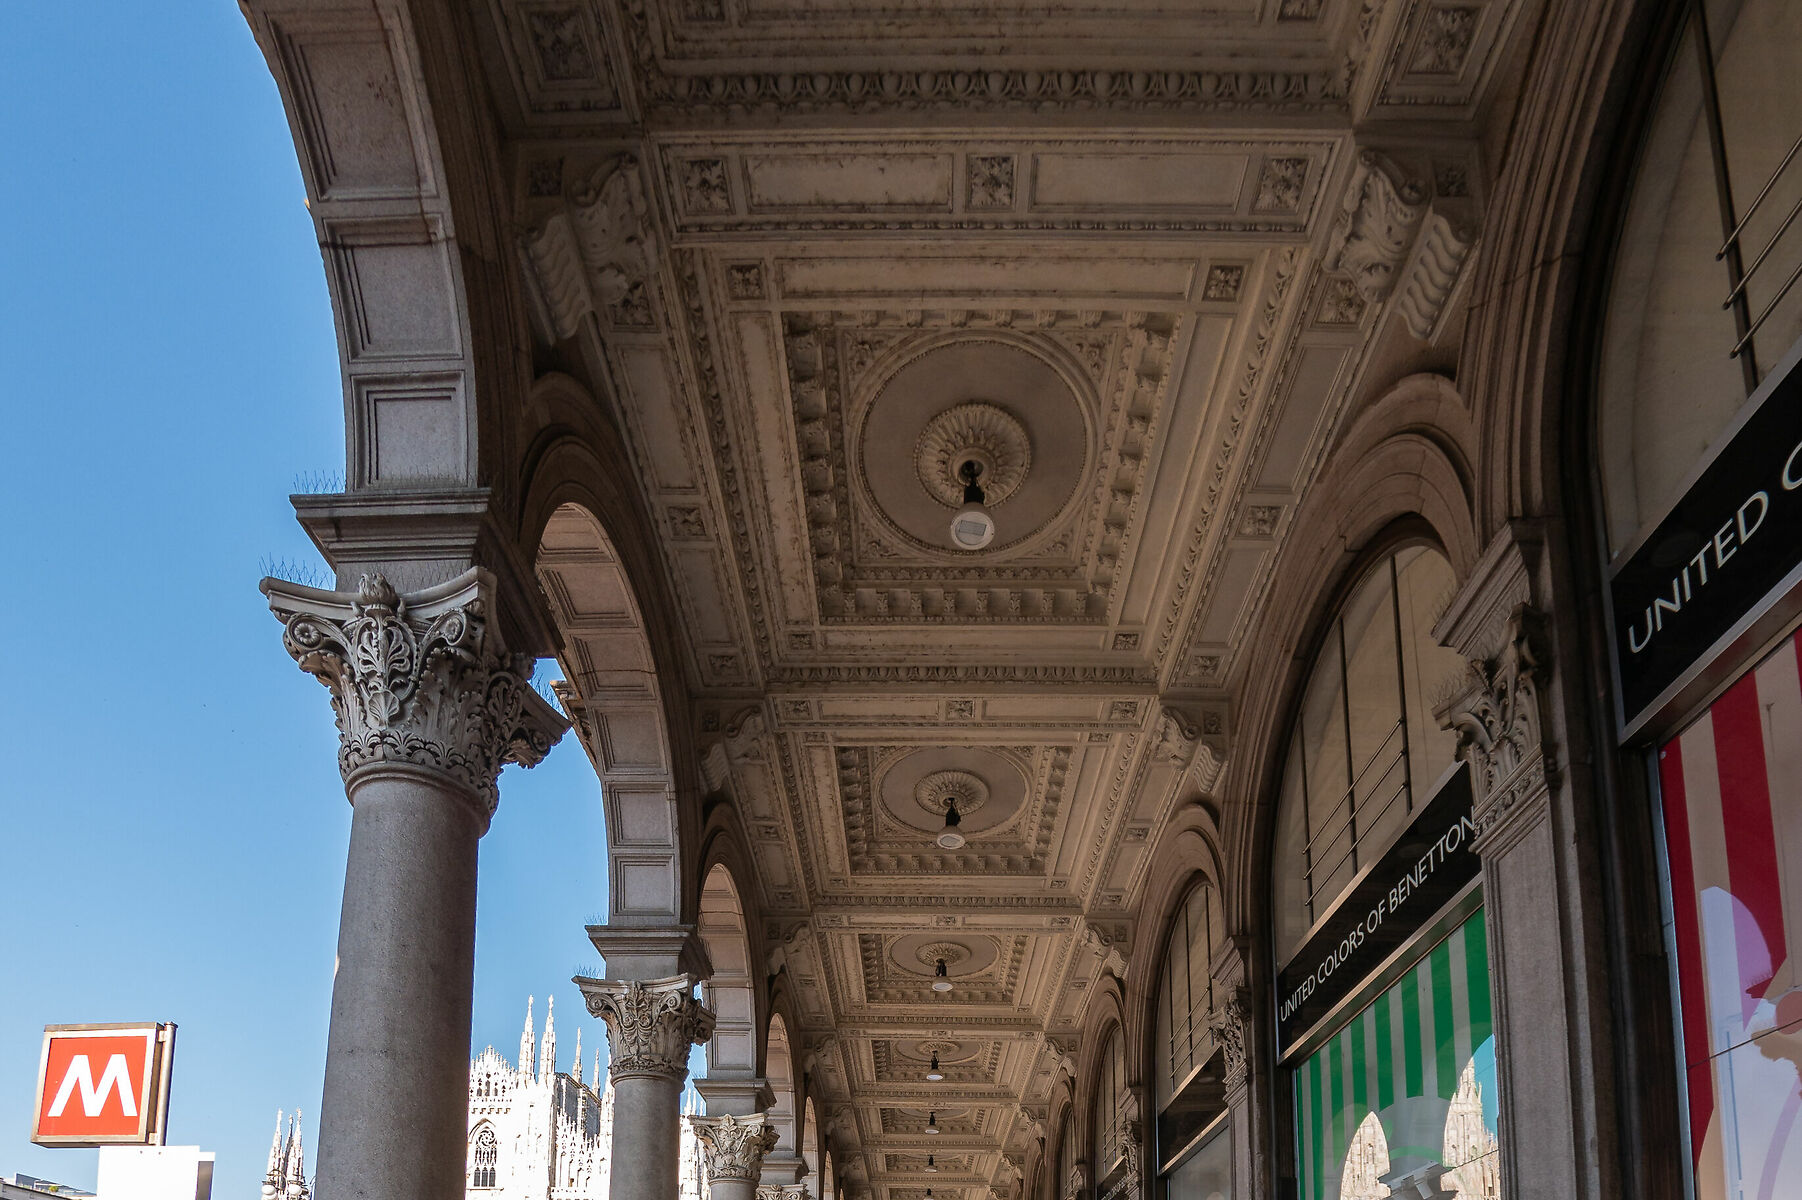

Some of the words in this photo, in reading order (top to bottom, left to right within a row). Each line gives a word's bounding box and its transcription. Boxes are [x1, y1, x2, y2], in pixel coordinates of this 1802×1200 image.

[1629, 490, 1769, 653] UNITED
[1280, 975, 1316, 1022] UNITED
[1317, 922, 1366, 984] COLORS
[1366, 898, 1386, 934] OF
[1389, 805, 1475, 914] BENETTON
[47, 1053, 138, 1117] M
